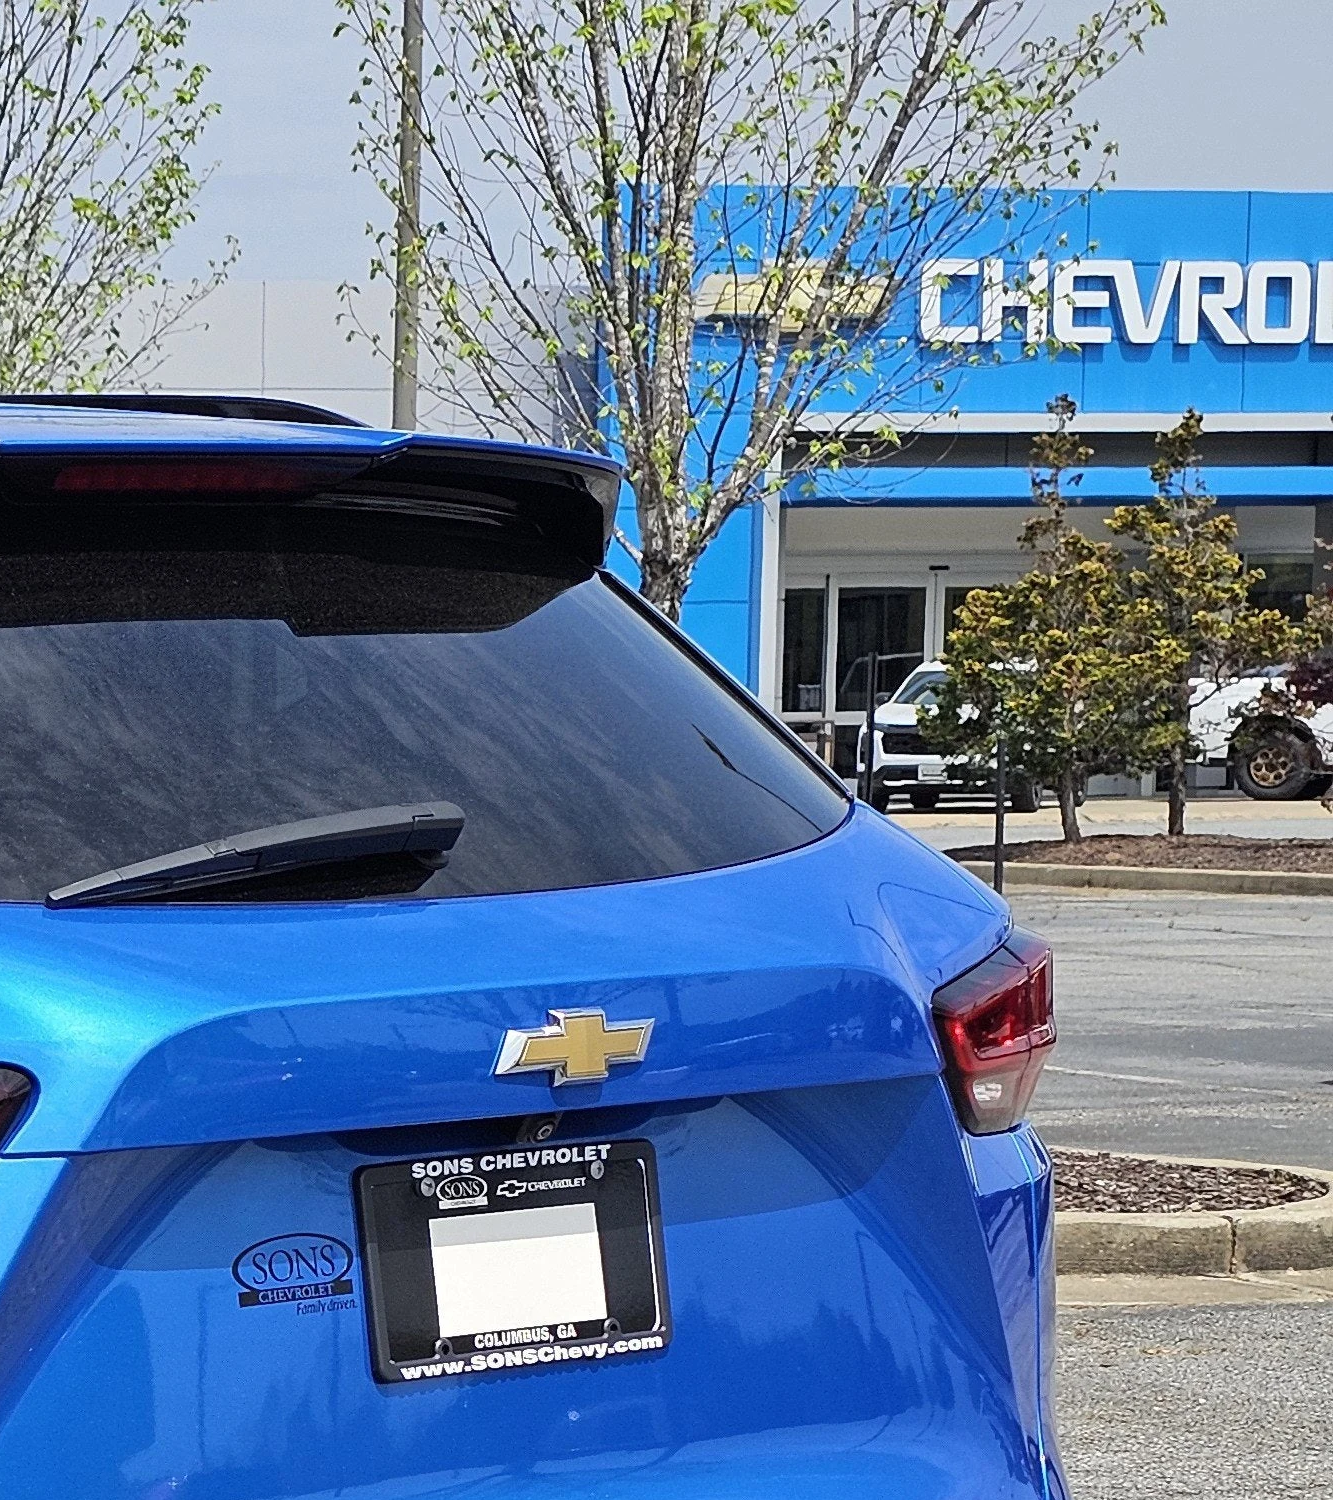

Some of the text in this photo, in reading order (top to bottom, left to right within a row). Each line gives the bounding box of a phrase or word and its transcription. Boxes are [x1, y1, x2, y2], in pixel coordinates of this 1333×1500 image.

[411, 1144, 612, 1179] SONS CHEVROLET
[444, 1180, 480, 1198] SONS
[527, 1176, 587, 1193] CHEVROLET
[252, 1244, 335, 1285] SONS
[258, 1283, 334, 1303] CHEVROLET
[296, 1300, 327, 1316] Family
[474, 1324, 577, 1349] COLUMBUS, GA
[400, 1335, 663, 1380] www.SONSChevy.com
